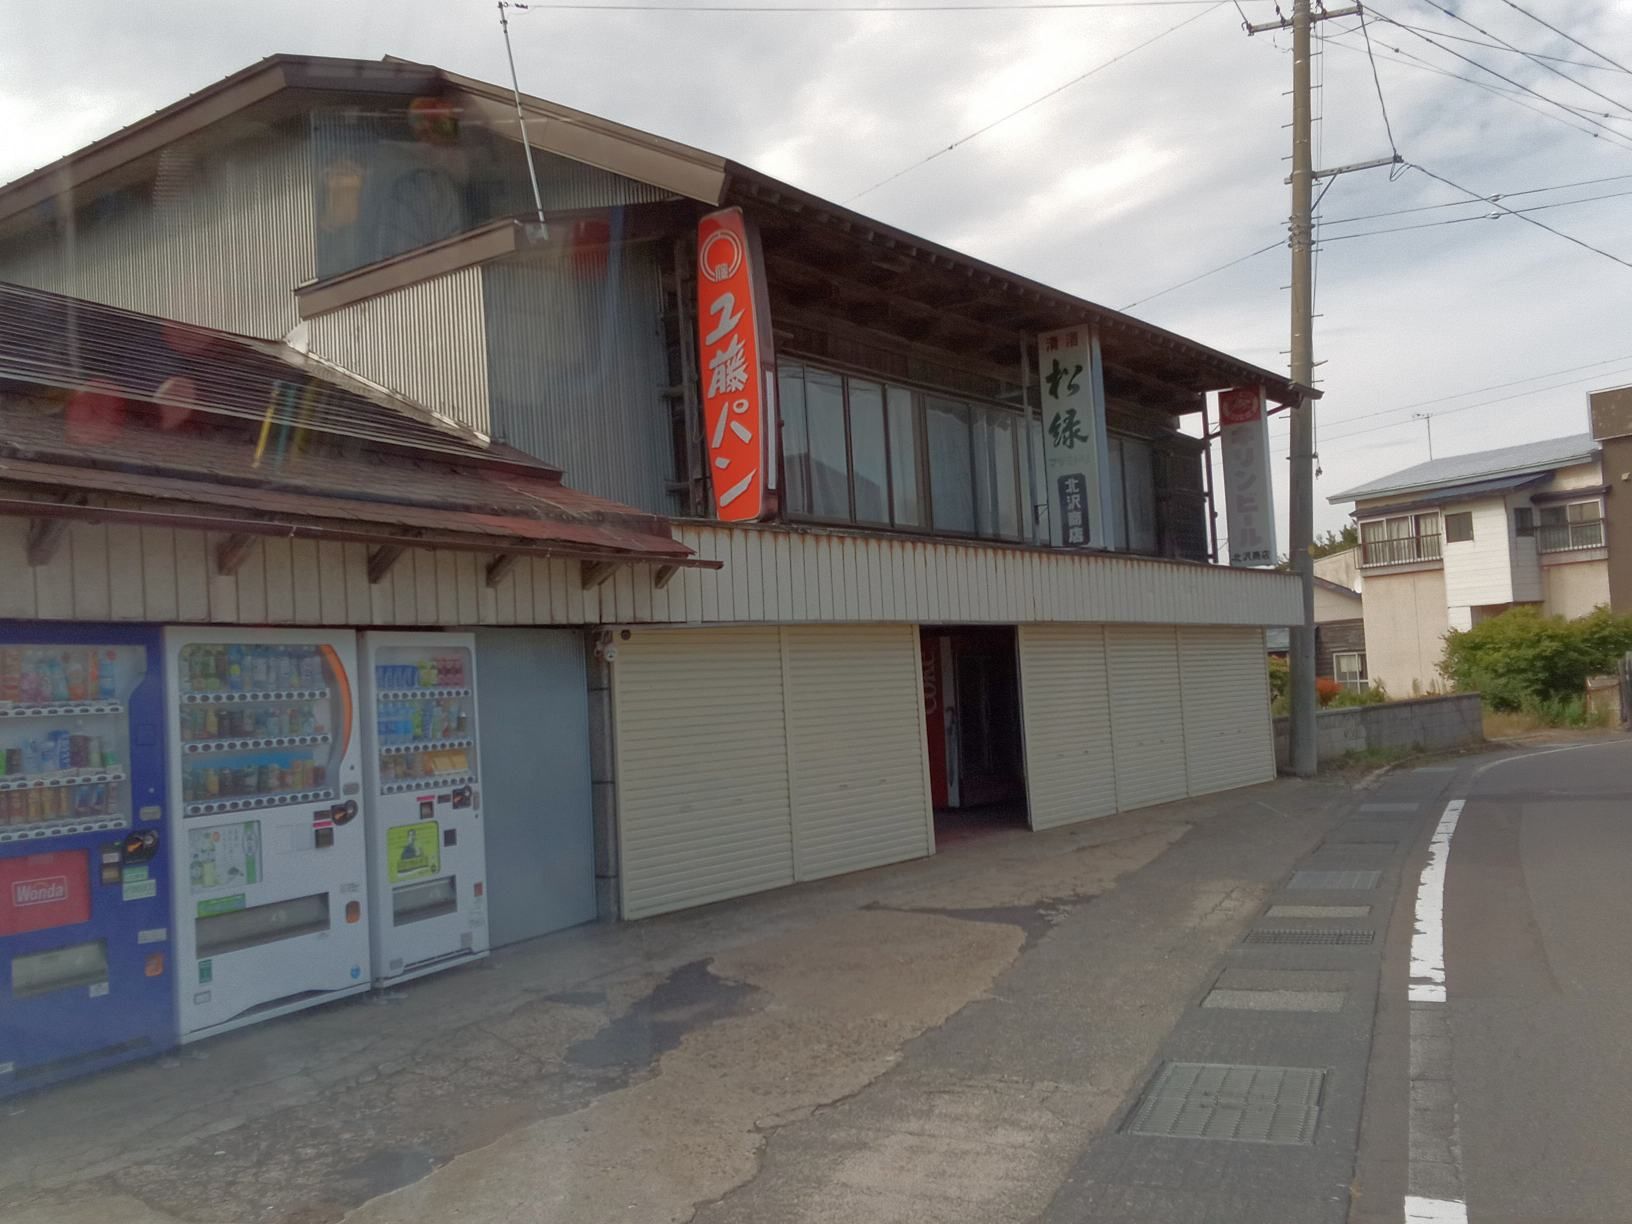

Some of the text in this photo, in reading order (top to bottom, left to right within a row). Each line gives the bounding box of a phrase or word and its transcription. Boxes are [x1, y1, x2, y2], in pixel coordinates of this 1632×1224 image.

[705, 292, 757, 507] 工藤パン
[1064, 478, 1085, 544] 北沢商店
[16, 882, 65, 902] Wonda
